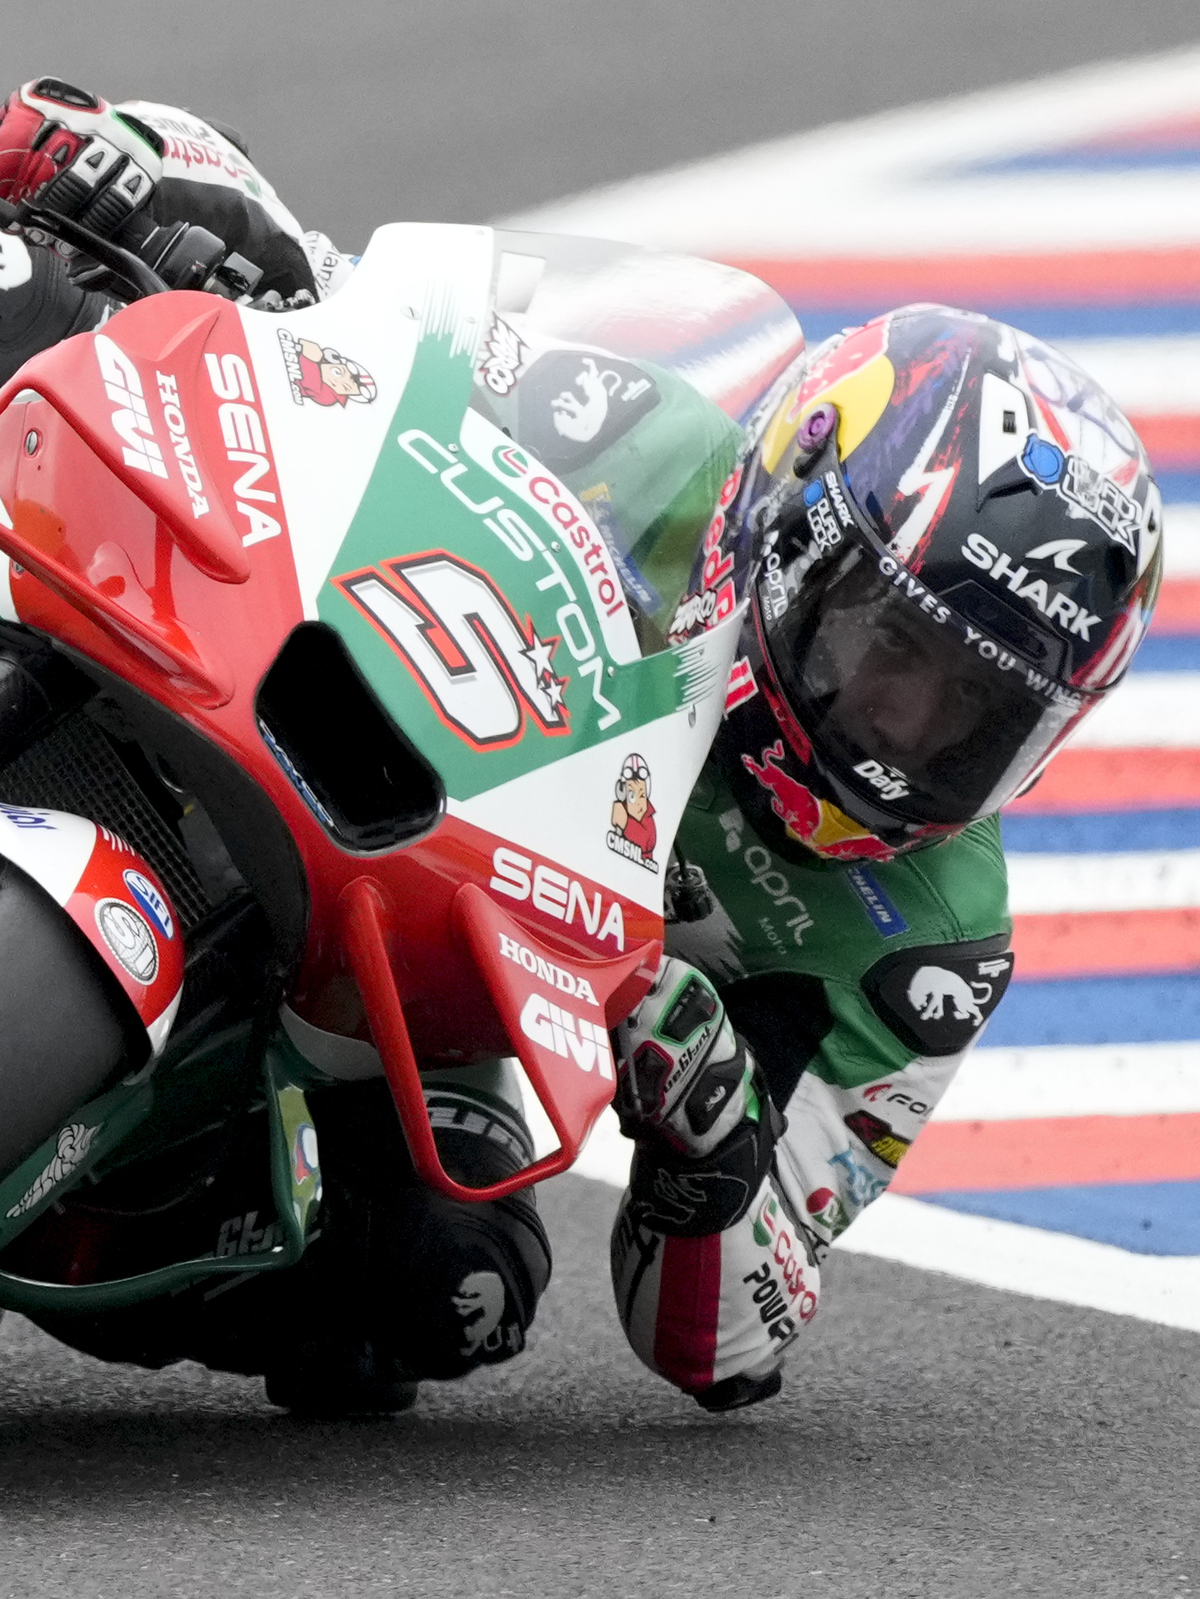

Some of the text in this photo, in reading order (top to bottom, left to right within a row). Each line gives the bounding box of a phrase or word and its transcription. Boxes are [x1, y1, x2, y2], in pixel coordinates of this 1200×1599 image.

[156, 370, 210, 519] HONDA
[204, 353, 282, 547] SENA
[824, 471, 855, 528] SHARK
[528, 476, 625, 618] Castrol
[807, 505, 830, 552] LOCK
[816, 499, 844, 544] QUAD
[397, 428, 622, 731] CUSTOM
[878, 556, 951, 624] GIVES
[964, 625, 1017, 672] YOU
[961, 532, 1102, 643] SHARK
[329, 548, 571, 752] 5
[852, 759, 909, 800] Dafy
[489, 846, 624, 952] SENA
[498, 932, 600, 1006] HONDA
